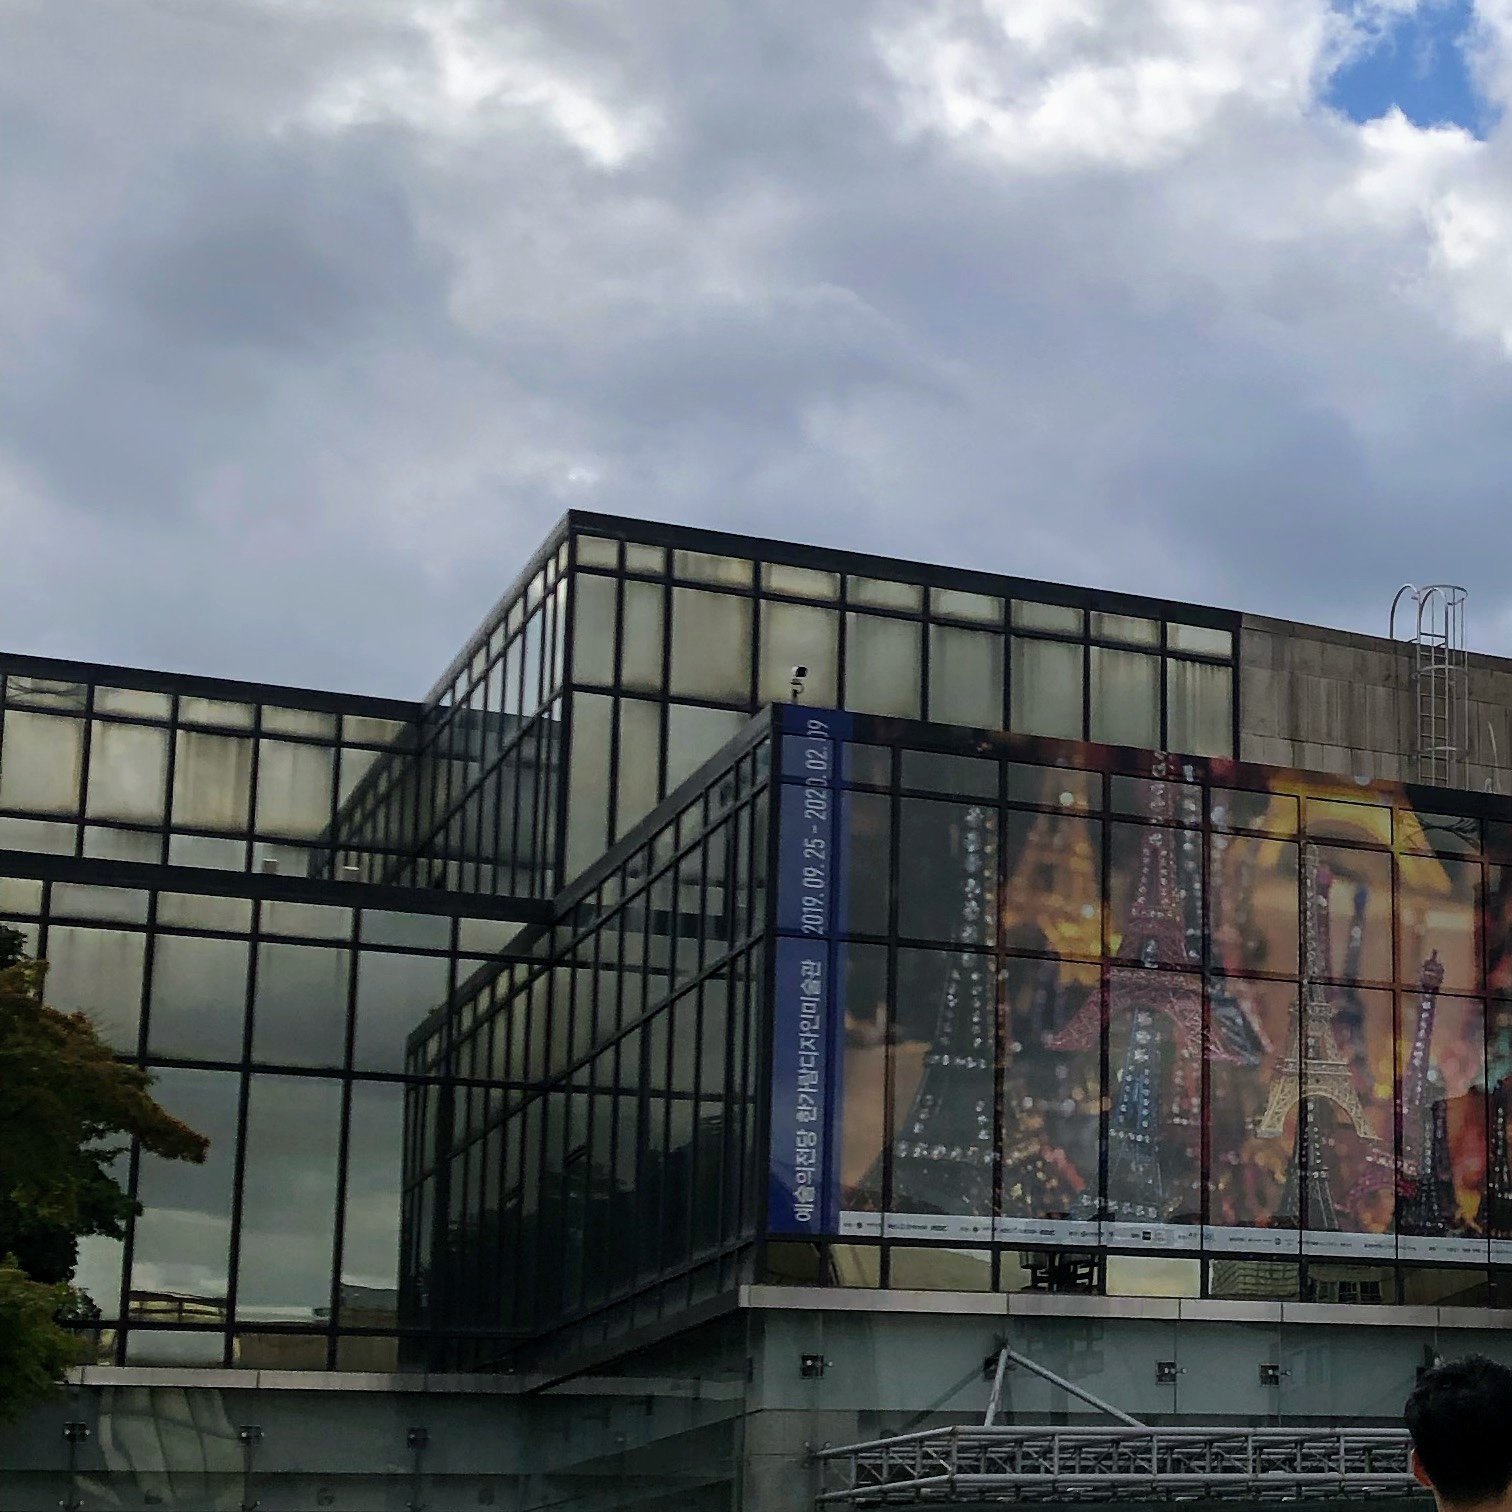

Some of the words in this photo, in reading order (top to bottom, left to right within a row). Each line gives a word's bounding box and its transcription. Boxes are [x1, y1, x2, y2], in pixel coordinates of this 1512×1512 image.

[803, 838, 826, 858] 25
[796, 959, 822, 1123] 한가람디자인미술관
[792, 1128, 818, 1222] 예술의전당
